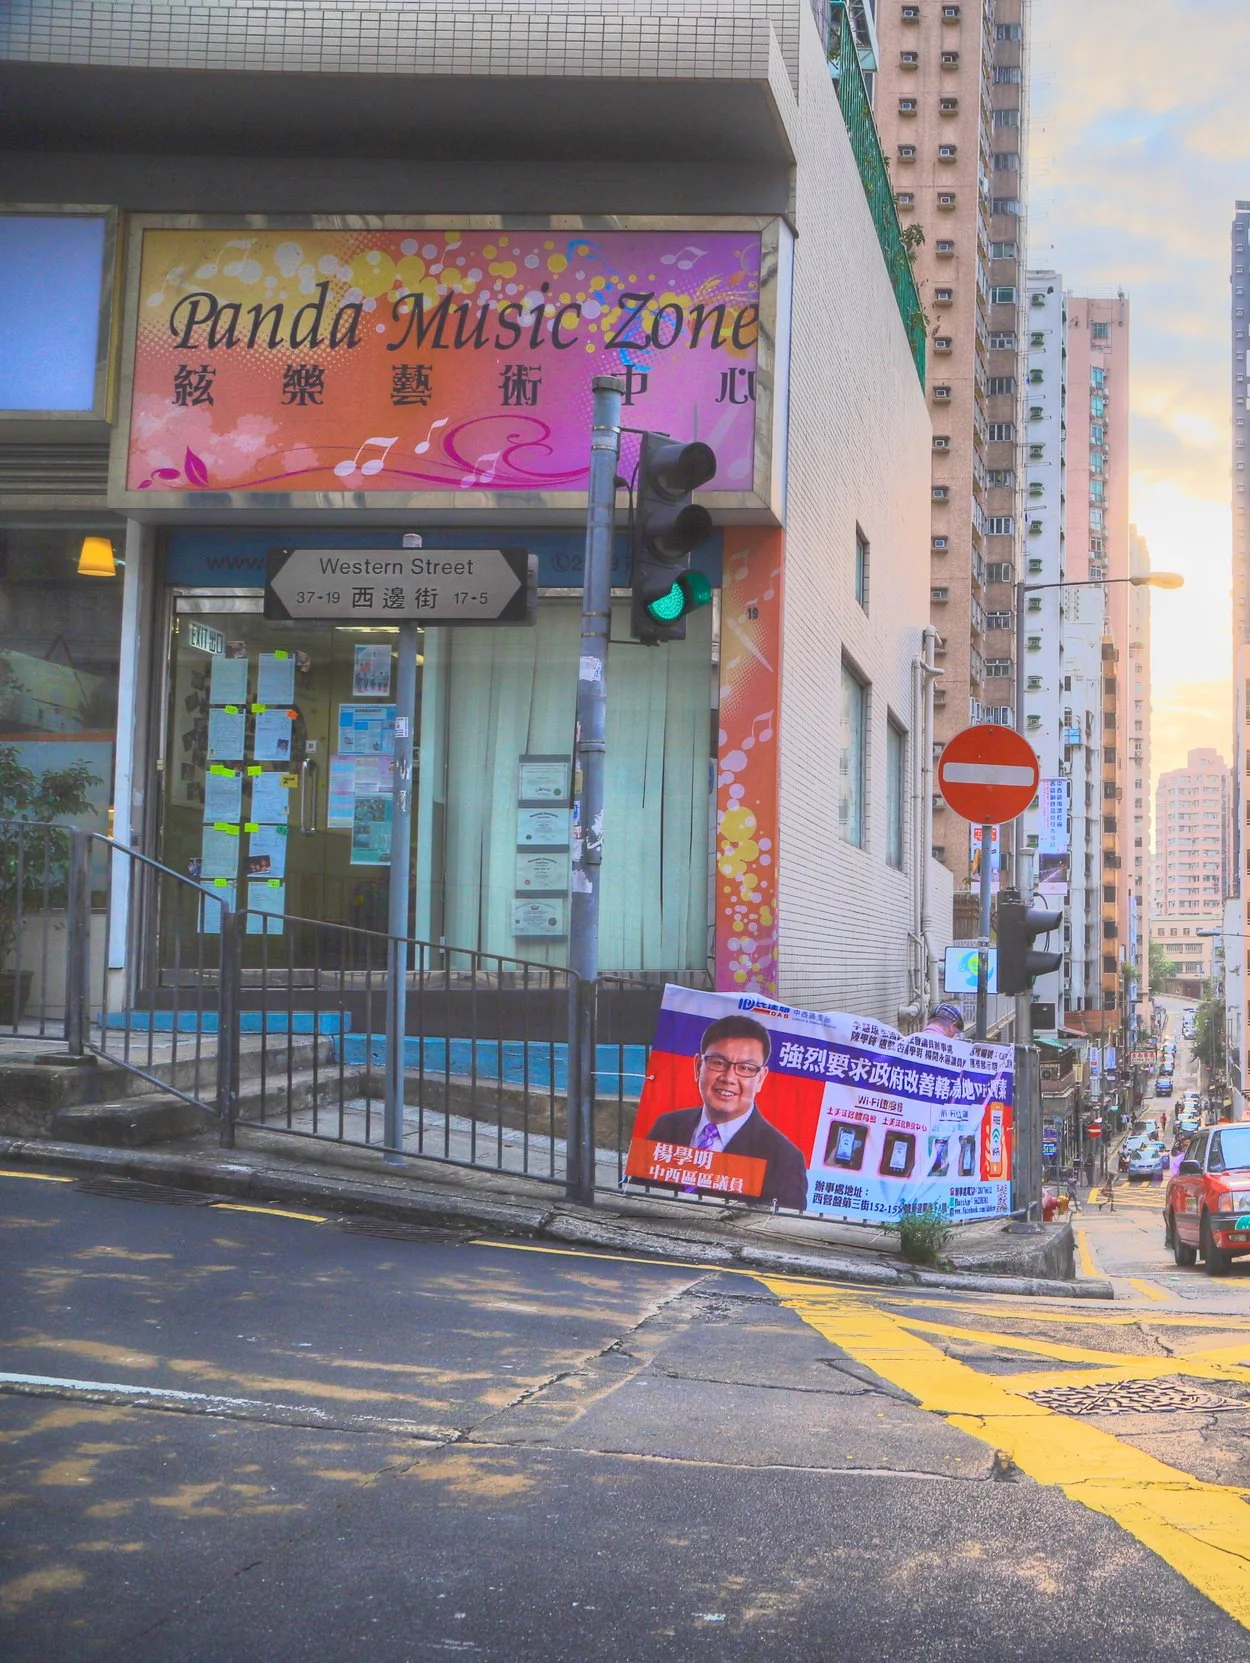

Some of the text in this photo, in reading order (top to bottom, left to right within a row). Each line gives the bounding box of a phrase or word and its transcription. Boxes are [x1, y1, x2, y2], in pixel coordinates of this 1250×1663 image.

[169, 280, 759, 351] Panda Music Zone
[319, 558, 474, 575] Western Street
[351, 587, 438, 609] 西邊街
[191, 624, 224, 653] EXIT 出口
[770, 1011, 789, 1019] DAB
[653, 1142, 714, 1170] 楊學明
[649, 1164, 744, 1193] 中西區區議員
